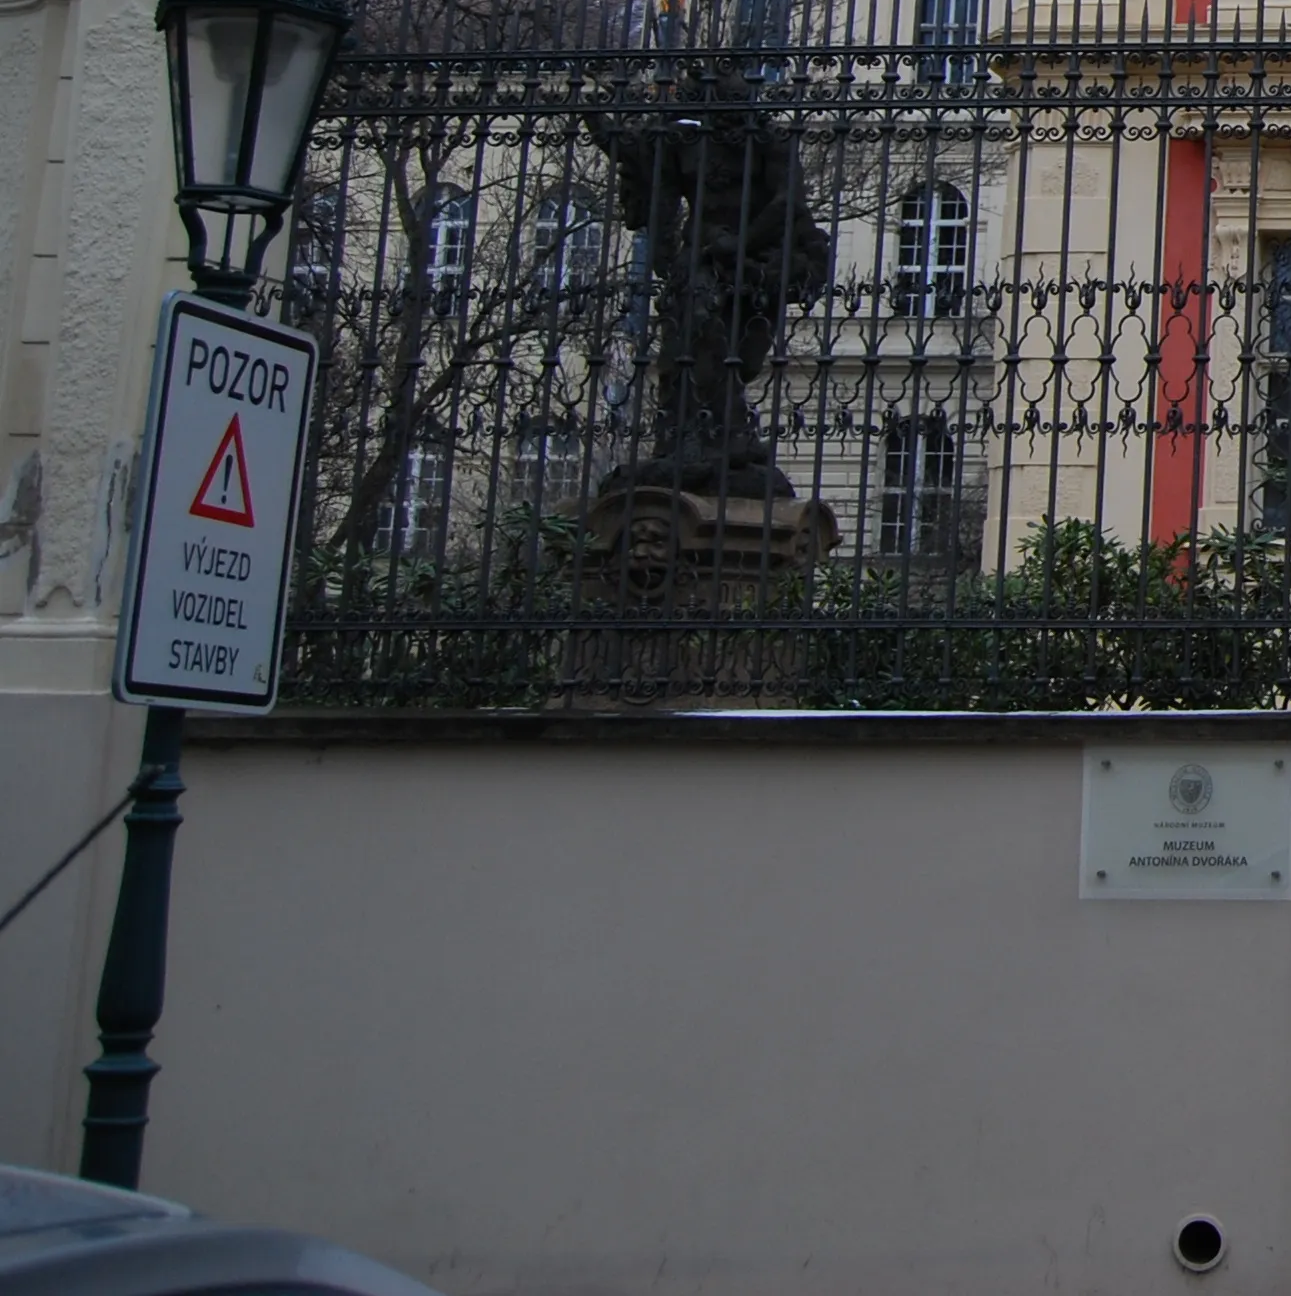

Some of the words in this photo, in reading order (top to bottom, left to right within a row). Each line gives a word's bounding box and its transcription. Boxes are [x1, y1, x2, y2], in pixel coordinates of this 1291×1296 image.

[186, 338, 290, 413] POZOR
[183, 535, 251, 582] VÝJEZD
[172, 589, 248, 631] VOZIDEL
[168, 639, 240, 677] STAVBY
[1128, 854, 1189, 867] ANTONÍNA
[1192, 854, 1248, 867] DVOŘÁKA
[1163, 840, 1215, 852] MUZEUM
